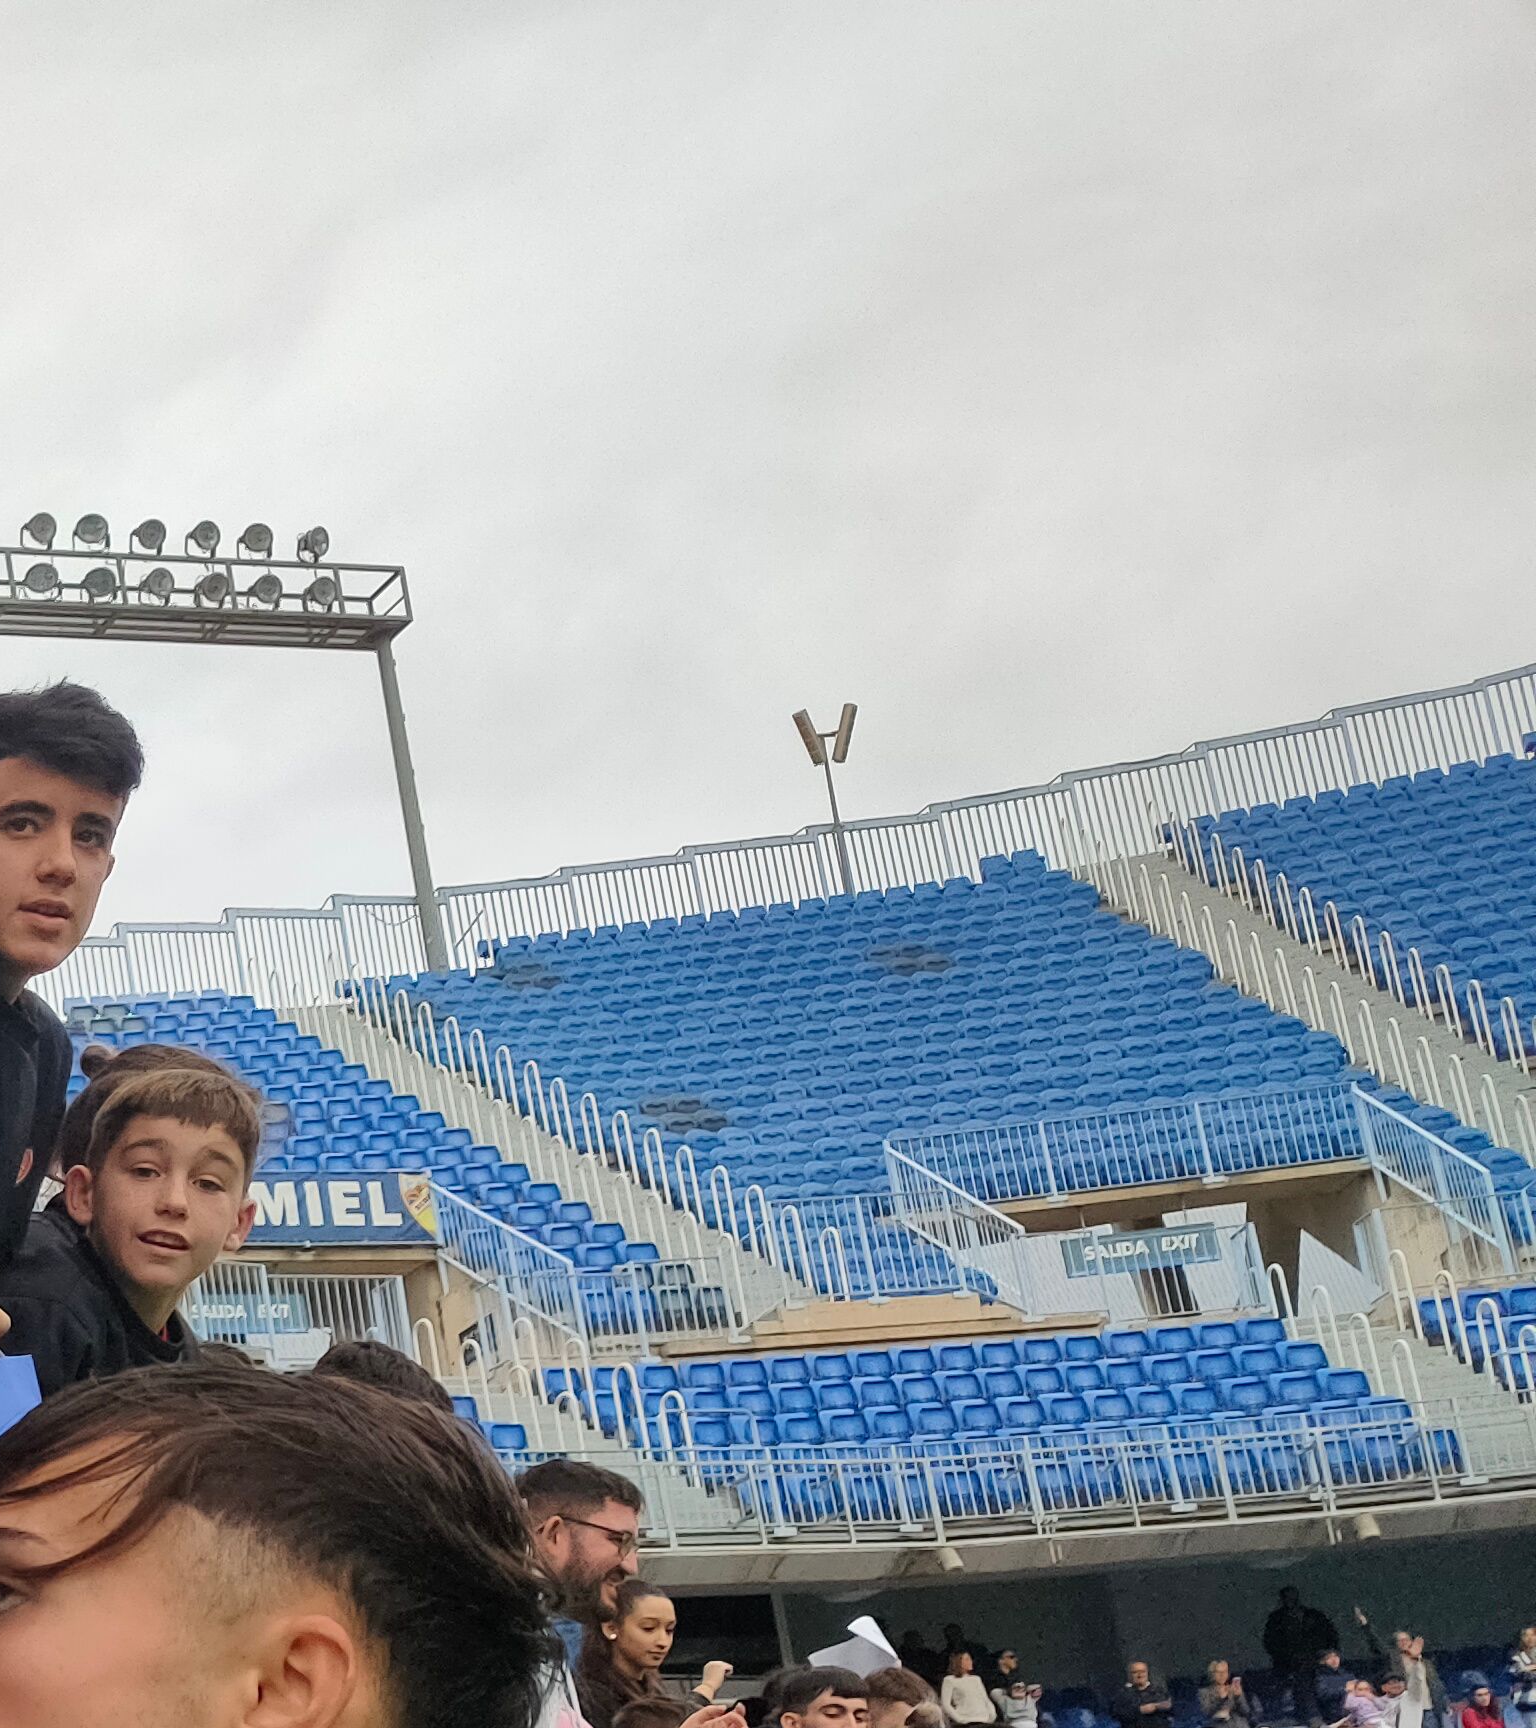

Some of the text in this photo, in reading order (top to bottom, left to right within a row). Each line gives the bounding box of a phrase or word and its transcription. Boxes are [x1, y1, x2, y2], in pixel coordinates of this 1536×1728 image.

[248, 1180, 402, 1227] MIEL
[1084, 1233, 1199, 1260] SALIDA EXIT
